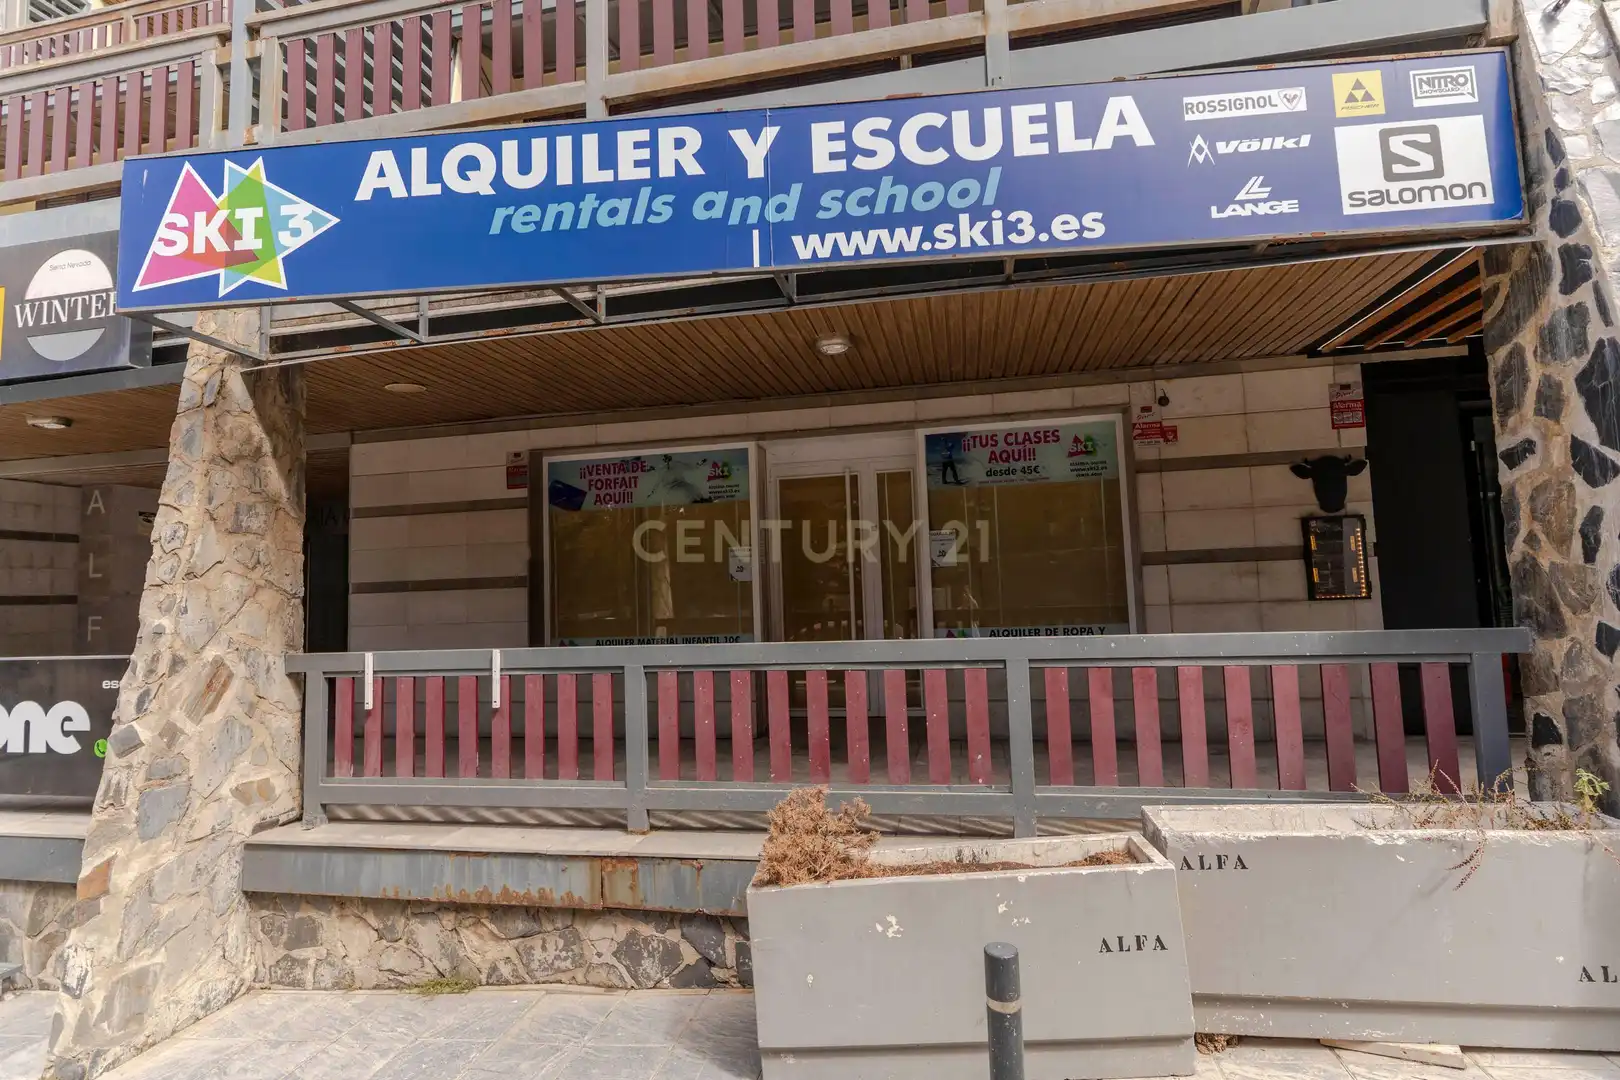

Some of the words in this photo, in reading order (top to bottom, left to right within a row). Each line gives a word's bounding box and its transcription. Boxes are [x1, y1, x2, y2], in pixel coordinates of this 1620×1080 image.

[1418, 73, 1469, 91] NITRO
[1184, 95, 1279, 115] ROSSIGNOL
[354, 126, 705, 202] ALQUILER
[728, 125, 781, 179] Y
[810, 95, 1156, 174] ESCUELA
[488, 186, 675, 235] rentals
[692, 182, 803, 226] and
[815, 166, 1002, 219] school
[1210, 199, 1300, 220] LANGE
[152, 206, 264, 257] SKI
[277, 202, 315, 249] 3
[791, 209, 1106, 260] www.ski3.es
[1004, 429, 1061, 446] CLASES
[631, 460, 647, 473] DE
[985, 467, 1017, 478] desde
[1019, 464, 1040, 474] 45€
[588, 475, 639, 491] FORFAIT
[989, 628, 1041, 638] ALQUILER
[1045, 628, 1059, 636] DE
[1063, 626, 1094, 636] ROPA
[1098, 626, 1106, 636] Y
[102, 680, 120, 690] es
[0, 700, 91, 755] ne
[1179, 853, 1249, 871] ALFA
[1098, 934, 1169, 953] ALFA
